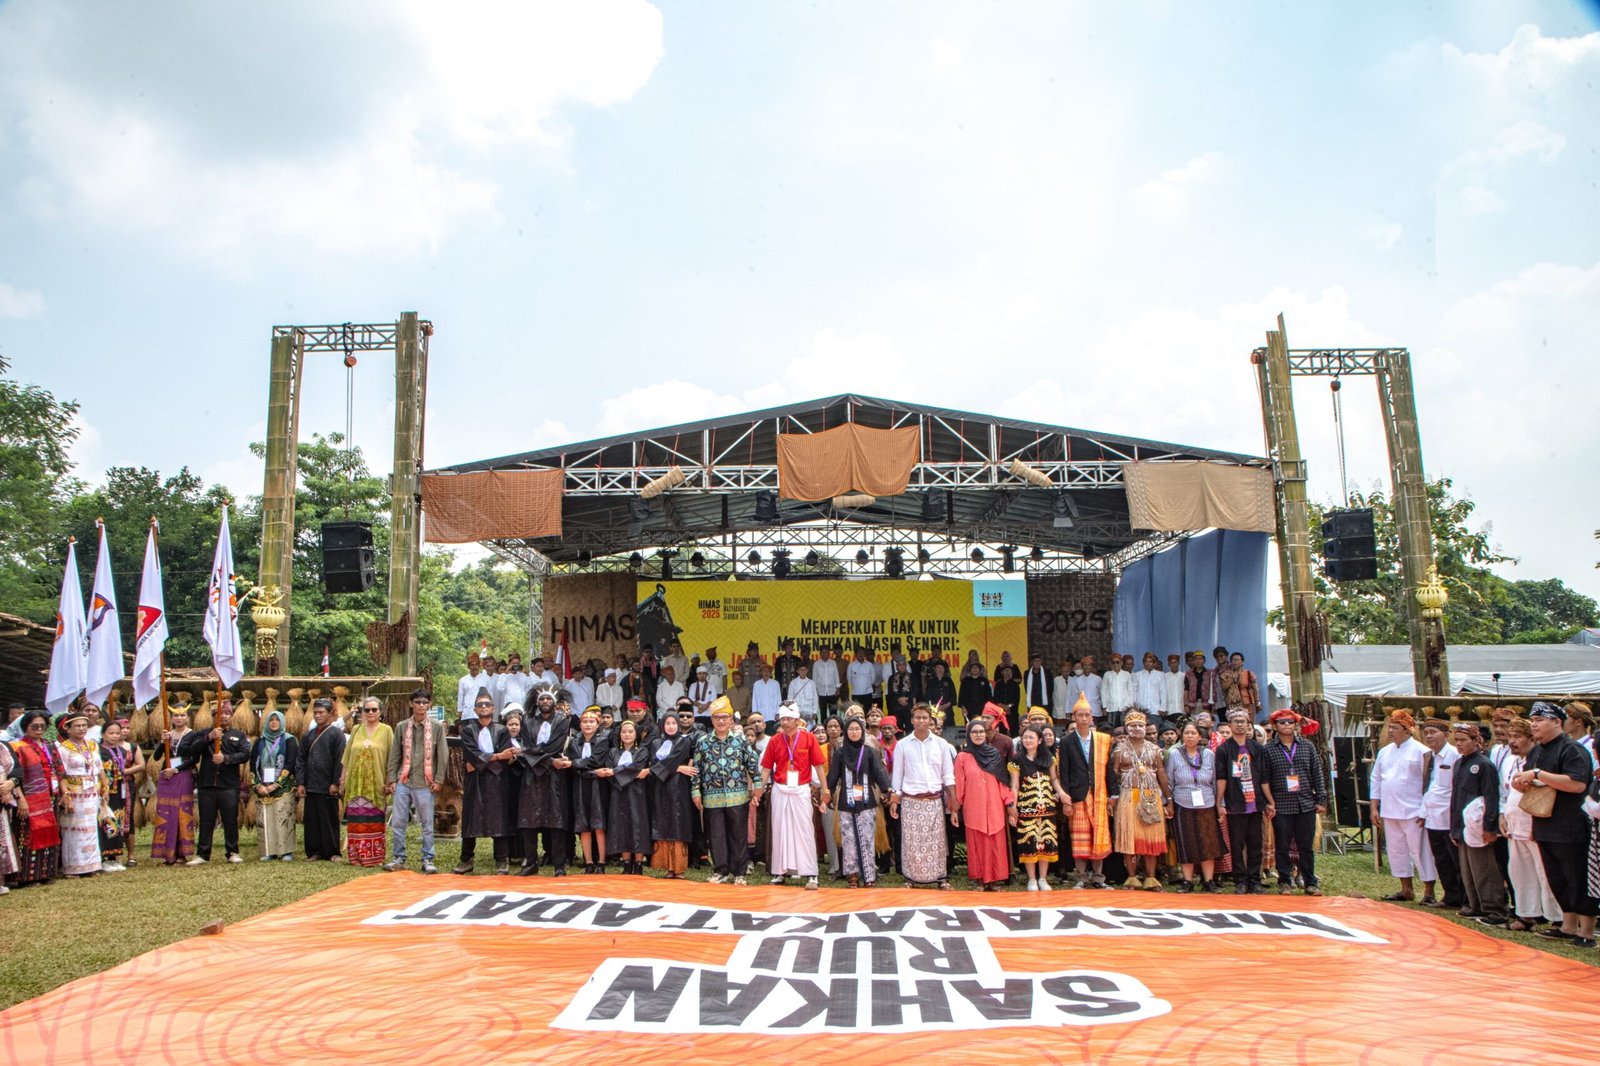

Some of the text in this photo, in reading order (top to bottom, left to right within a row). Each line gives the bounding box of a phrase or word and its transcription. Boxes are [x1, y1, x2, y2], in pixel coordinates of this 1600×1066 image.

[698, 599, 720, 609] HIMAS
[702, 609, 720, 619] 2025
[551, 612, 635, 643] HIMAS
[801, 618, 959, 635] MEMPERKUAT HAK UNTUK
[1038, 608, 1107, 634] 2025
[907, 635, 960, 651] SENDIRI:
[394, 893, 1357, 938] MASYARAKAT ADAT
[751, 935, 977, 976] RUU
[586, 965, 1141, 1028] SAHKAN
